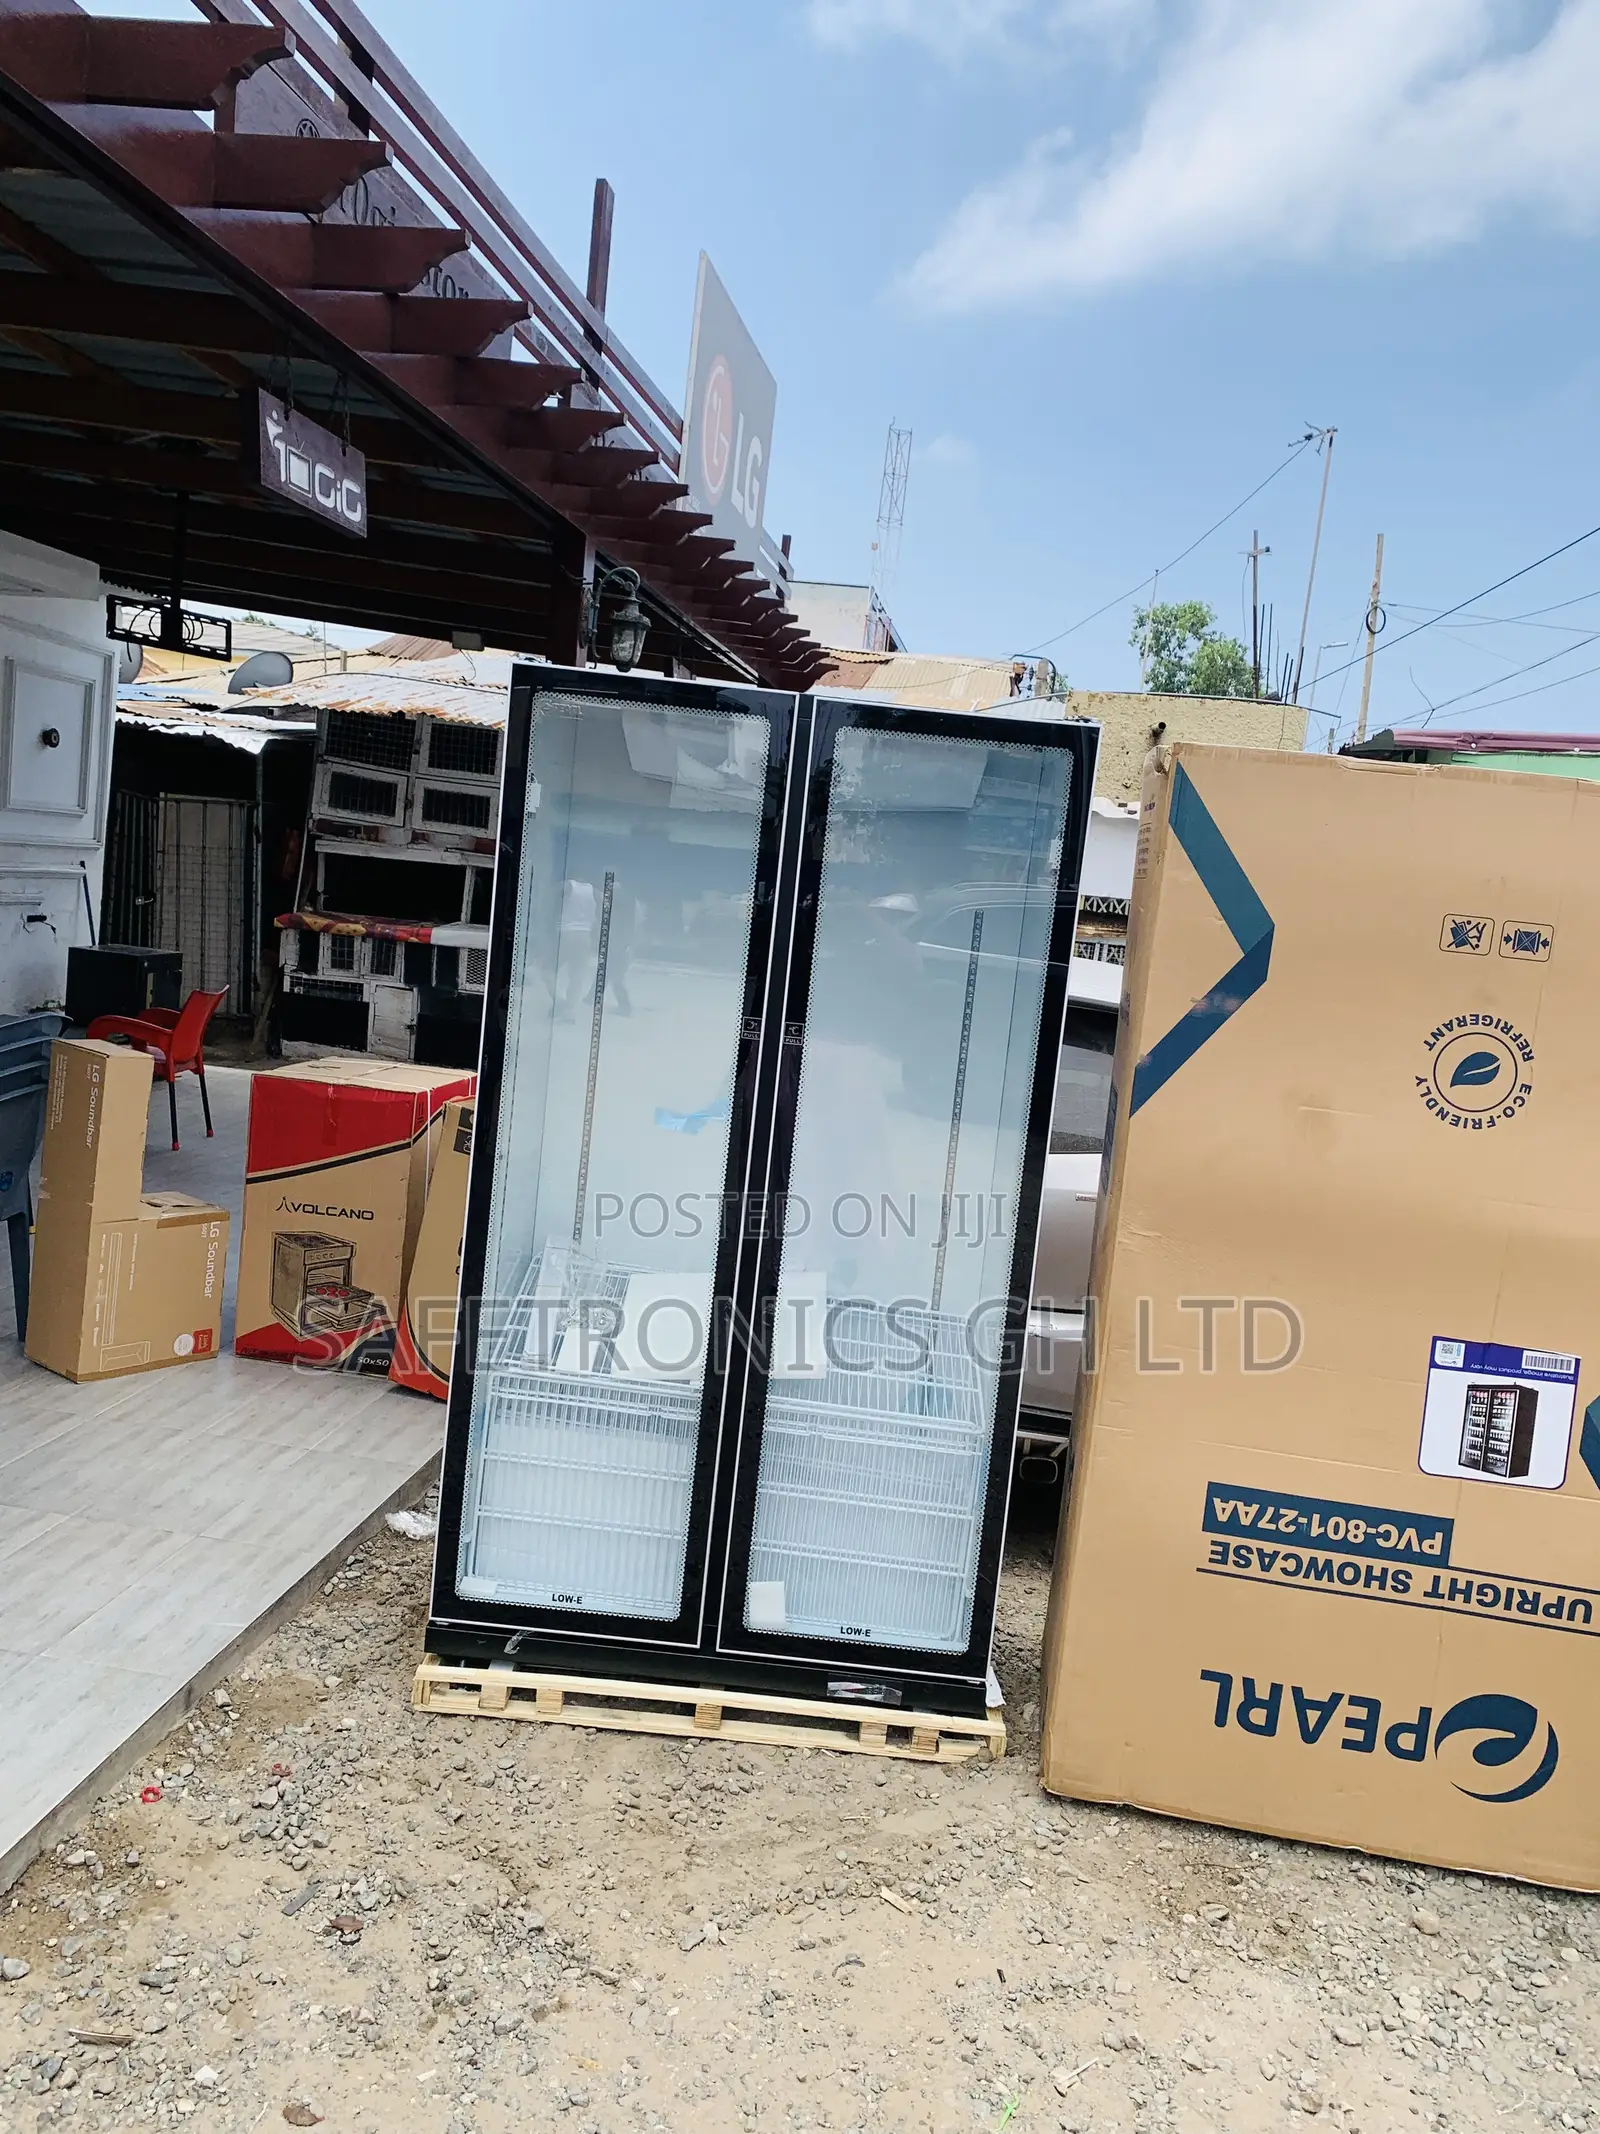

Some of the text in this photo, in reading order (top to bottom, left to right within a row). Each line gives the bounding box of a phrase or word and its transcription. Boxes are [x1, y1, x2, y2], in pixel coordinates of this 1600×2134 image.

[731, 411, 762, 528] LG
[1423, 1014, 1535, 1062] REFRIGERANT
[86, 1064, 100, 1149] LG Soundbar
[1415, 1076, 1532, 1130] ECO-FRIENDLY
[290, 1202, 375, 1221] VOLCANO
[204, 1221, 221, 1298] LG Soundbar
[356, 1355, 390, 1366] 50x50
[1544, 1373, 1574, 1381] Illustrative
[1213, 1497, 1444, 1556] PVC-801-27AA
[551, 1593, 583, 1605] LOW-E
[1208, 1540, 1593, 1624] UPRIGHT SHOWCASE
[840, 1625, 872, 1637] LOW-E
[1200, 1669, 1433, 1763] PEARL
